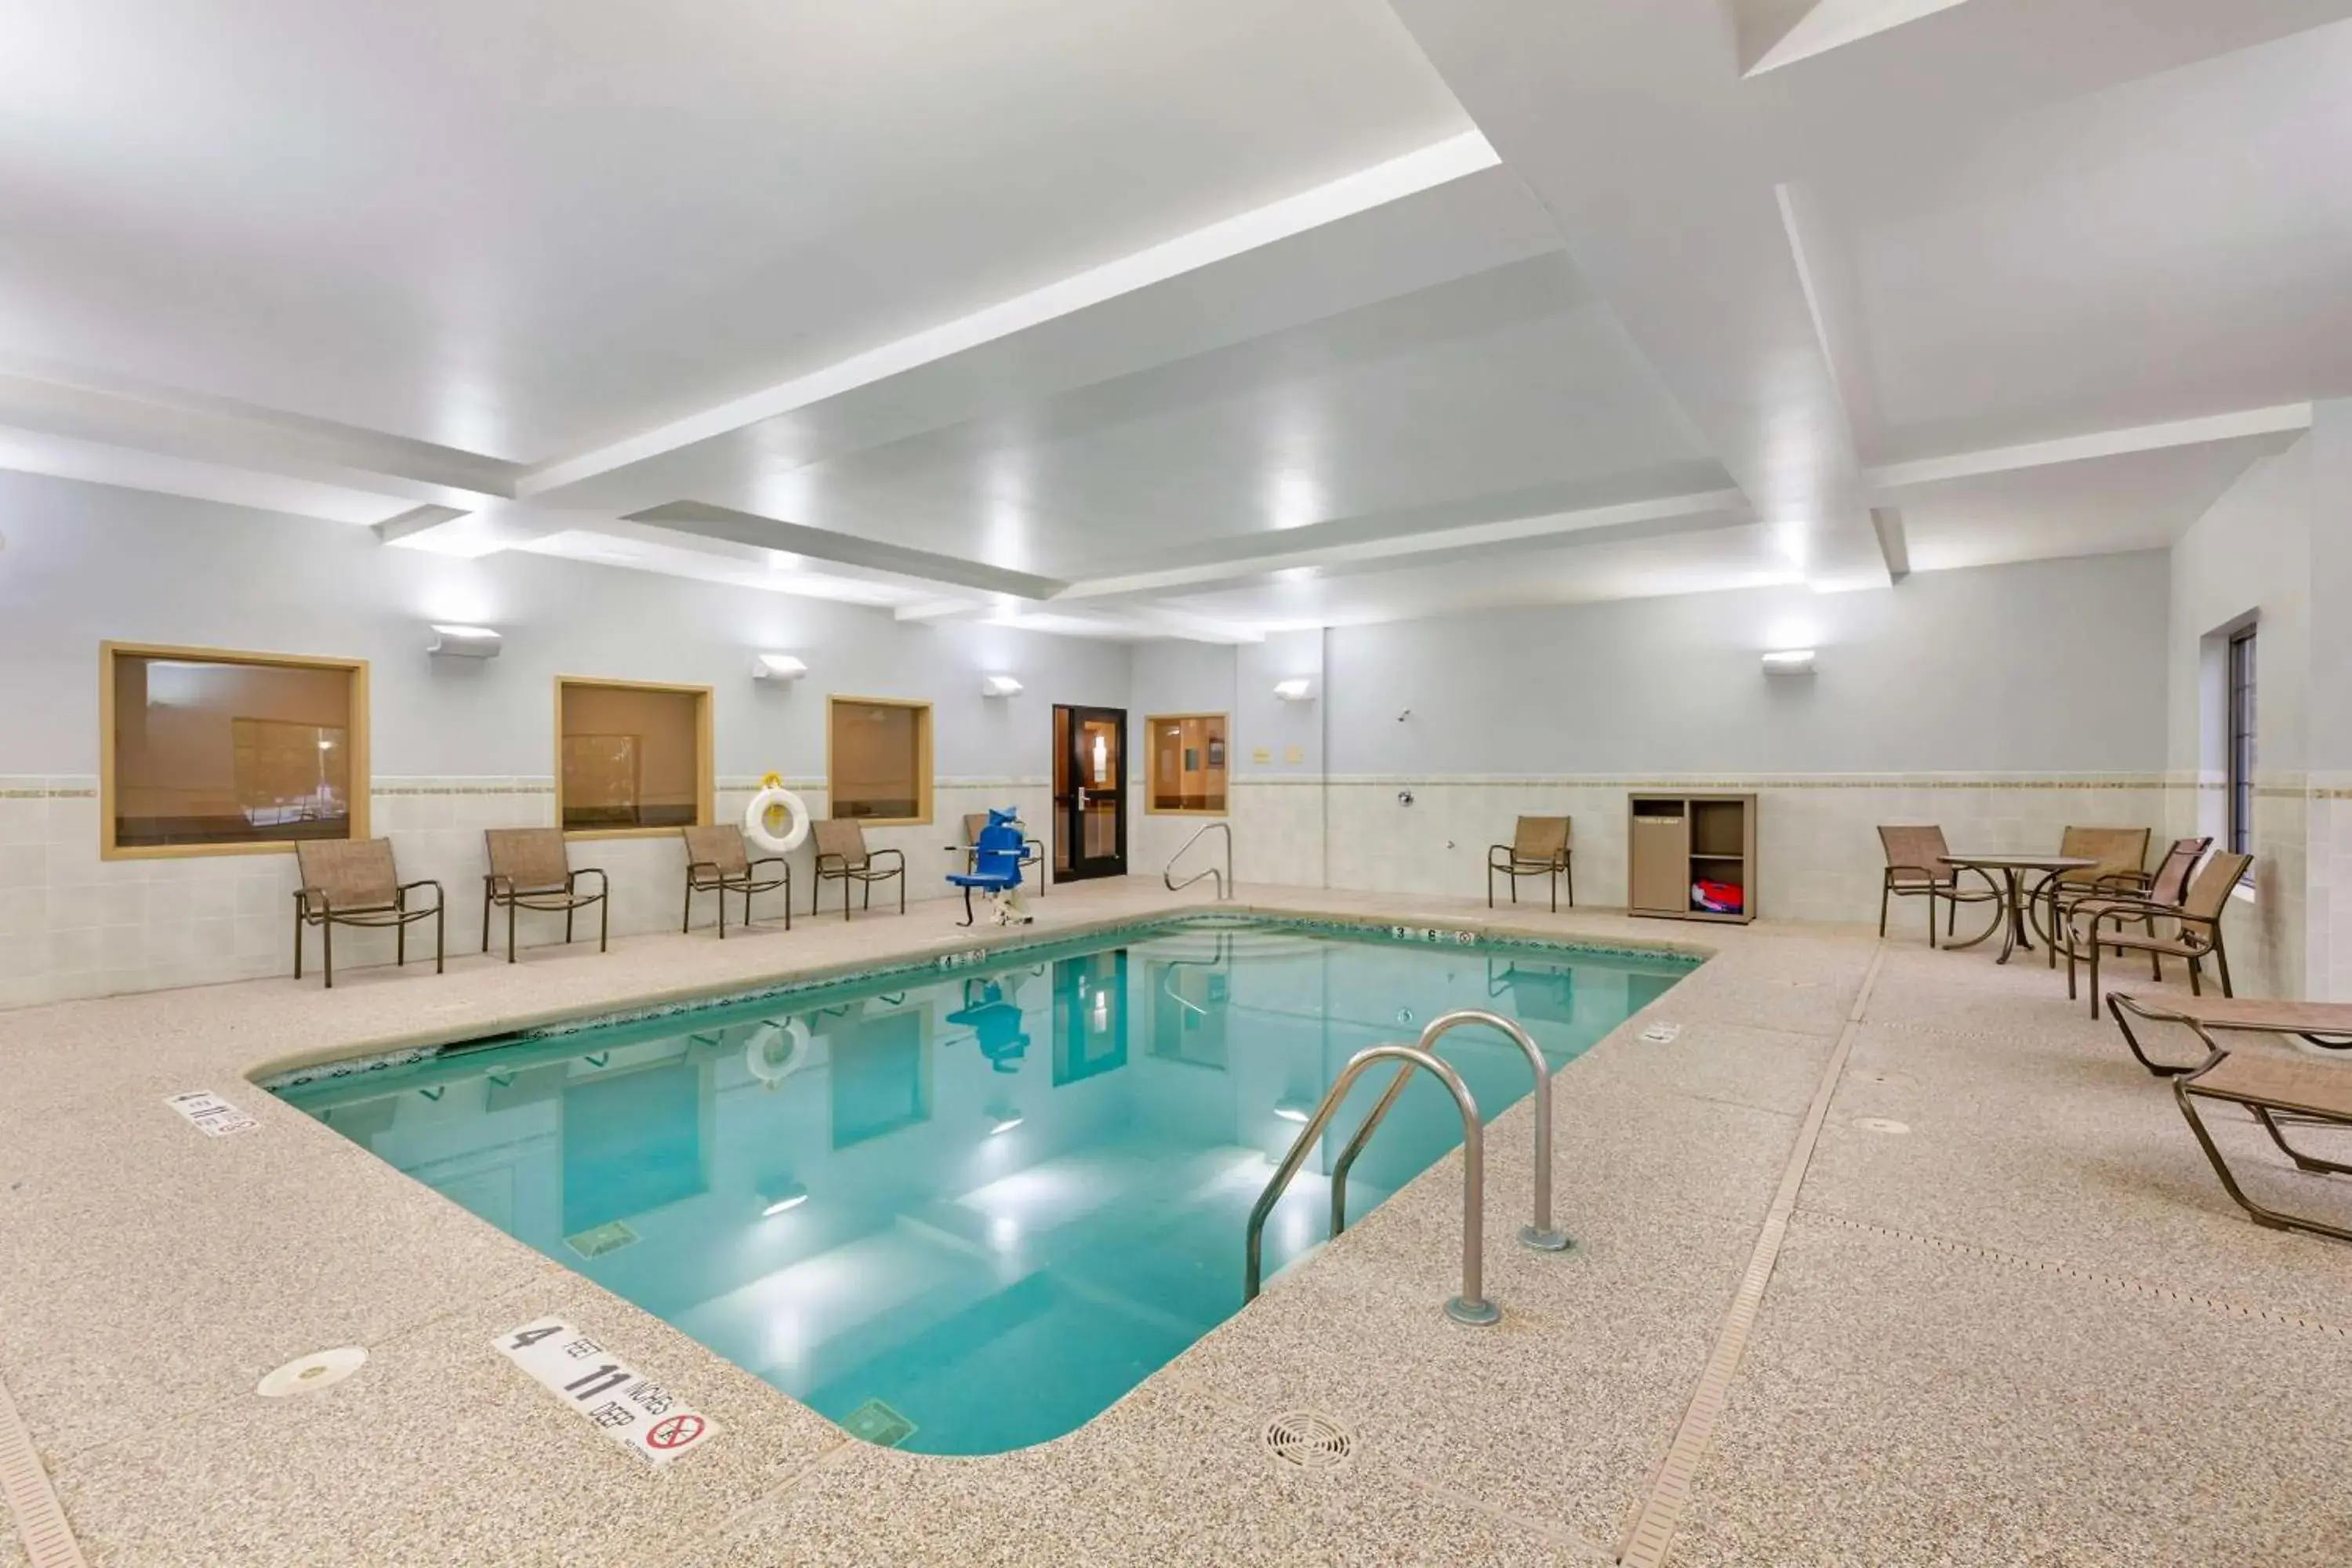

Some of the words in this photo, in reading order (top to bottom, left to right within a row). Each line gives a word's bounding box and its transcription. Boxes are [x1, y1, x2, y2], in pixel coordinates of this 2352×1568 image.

[1396, 927, 1404, 939] 3
[510, 1325, 564, 1350] 4
[563, 1338, 603, 1360] FEET
[564, 1364, 632, 1401] 11
[624, 1380, 677, 1416] INCHES
[589, 1400, 636, 1429] DEEP
